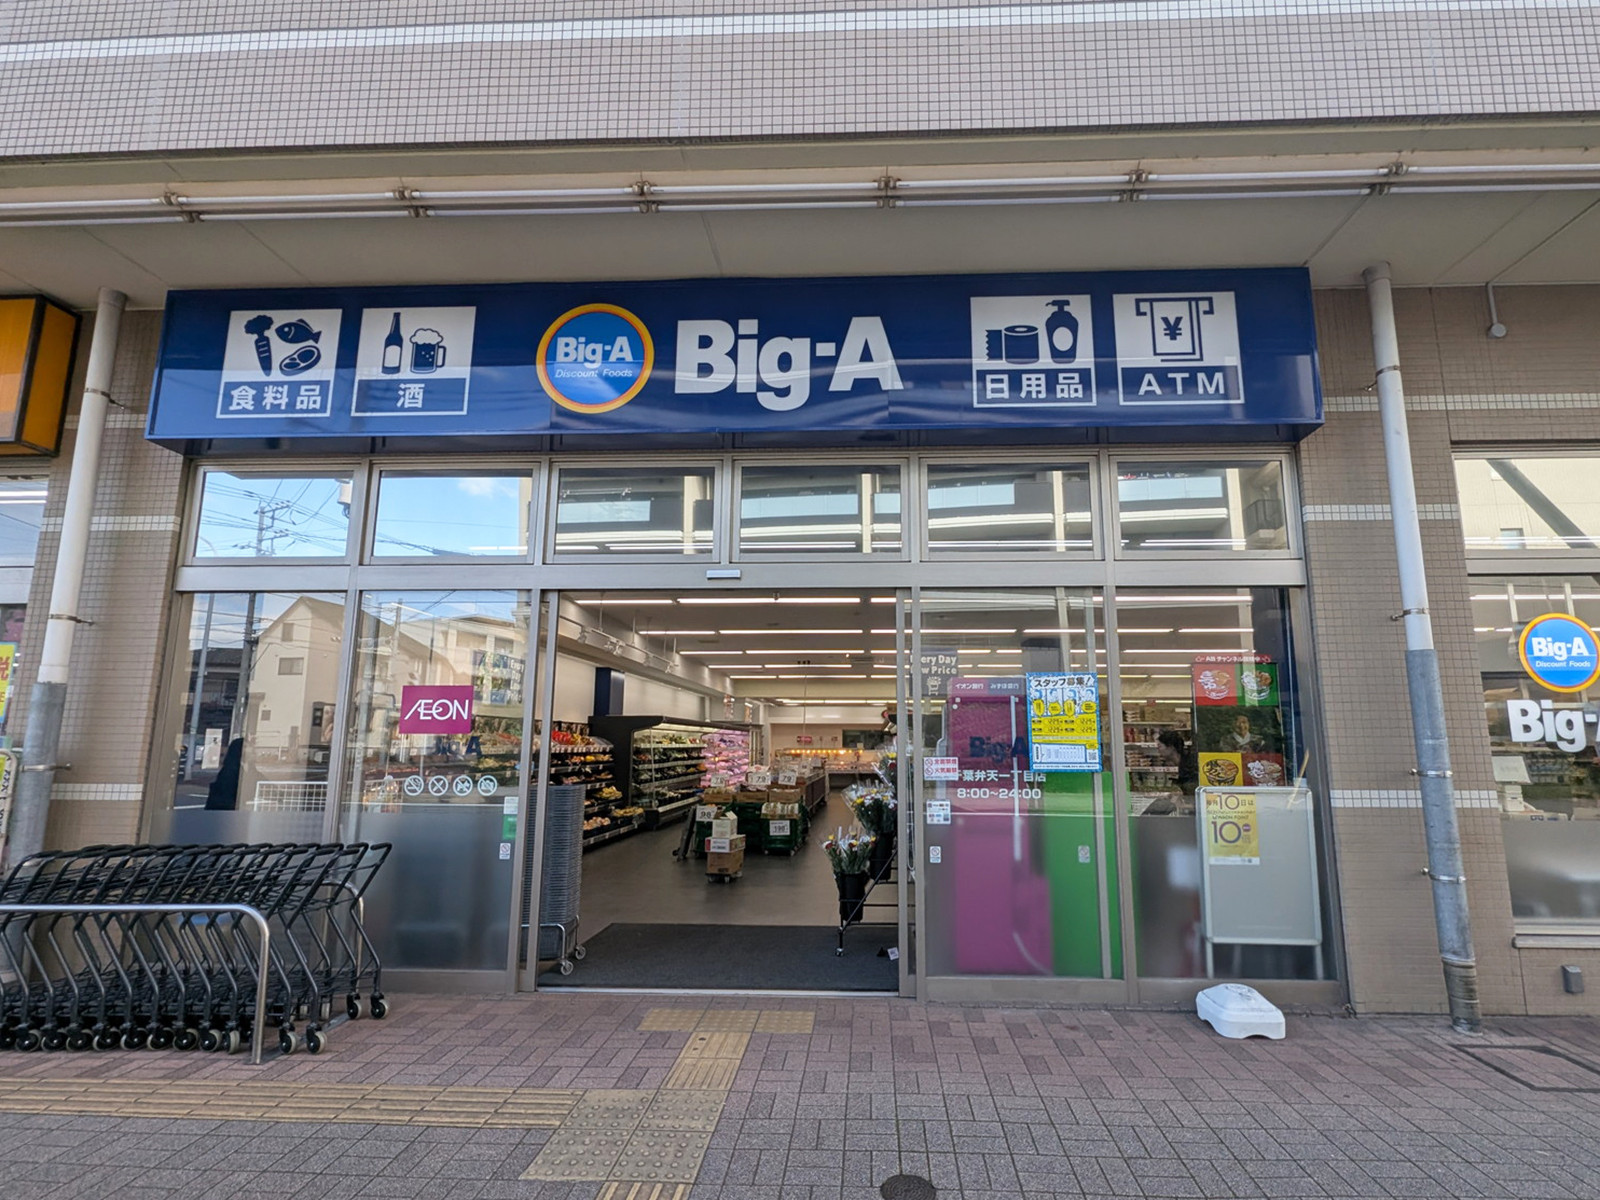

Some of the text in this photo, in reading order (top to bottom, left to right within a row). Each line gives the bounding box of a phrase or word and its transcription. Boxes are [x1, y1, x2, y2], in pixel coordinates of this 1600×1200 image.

[555, 336, 634, 369] Big-A
[674, 316, 904, 412] Big-A
[554, 369, 633, 378] Discount Foods
[984, 373, 1084, 398] 日用品
[1137, 371, 1226, 396] ATM
[228, 383, 322, 411] 食料品
[396, 383, 425, 409] 酒
[938, 655, 957, 665] Day
[1531, 637, 1590, 661] Big-A
[931, 666, 957, 674] Price
[1535, 660, 1591, 668] Discount Foods
[1507, 700, 1600, 753] Big-
